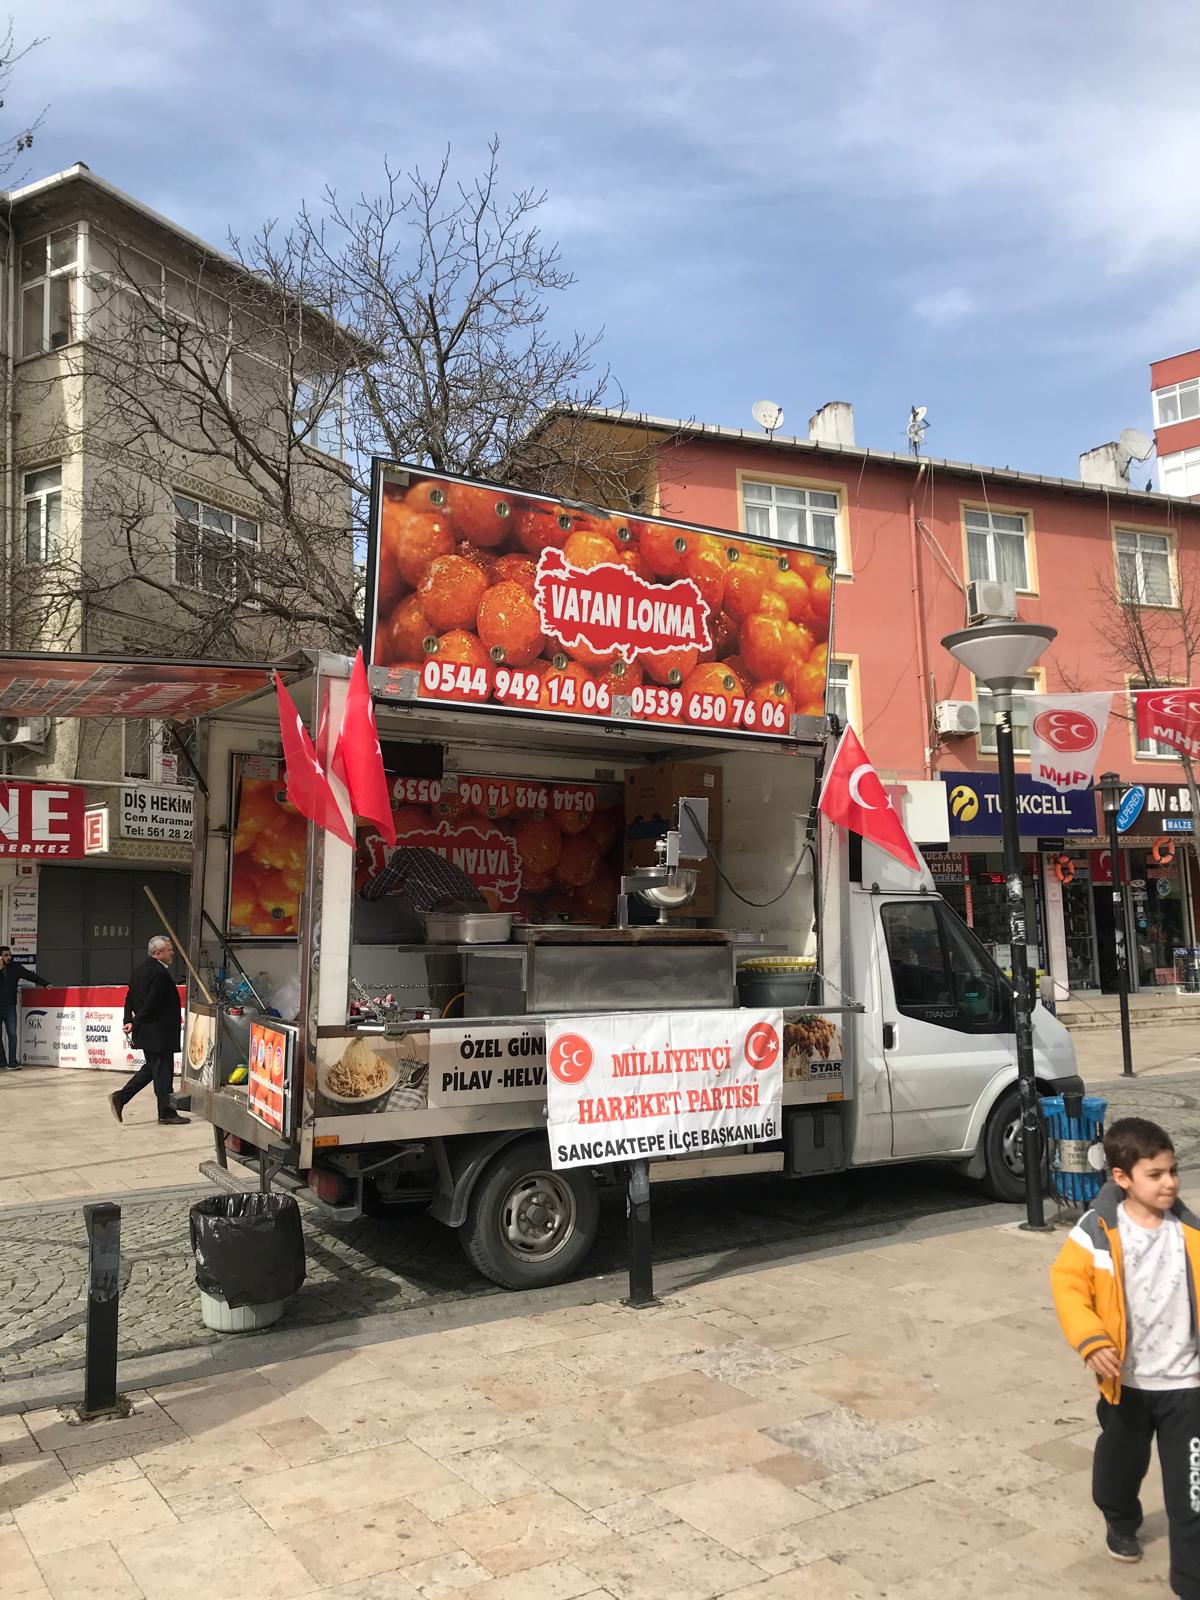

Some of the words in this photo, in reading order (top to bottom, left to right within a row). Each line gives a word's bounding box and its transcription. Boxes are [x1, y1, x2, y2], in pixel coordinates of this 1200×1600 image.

[551, 585, 621, 628] VATAN
[627, 597, 696, 639] LOKMA
[424, 661, 488, 695] 0544
[494, 670, 539, 701] 942
[548, 677, 575, 706] 14
[582, 682, 609, 710] 06
[631, 688, 683, 718] 0539
[689, 695, 726, 723] 650
[732, 700, 756, 726] 76
[761, 703, 785, 728] 06
[1153, 725, 1200, 754] MHP
[1040, 764, 1087, 786] MHP
[124, 790, 146, 813] DİŞ
[393, 779, 441, 802] 0539
[460, 783, 482, 805] 06
[488, 785, 509, 806] 14
[515, 787, 548, 809] 942
[553, 790, 595, 812] 0544
[1148, 787, 1167, 812] AV
[1169, 795, 1180, 812] &
[124, 813, 148, 823] Cem
[1118, 790, 1142, 827] ALPEREN
[125, 825, 144, 836] Tel:
[147, 828, 165, 838] 561
[168, 829, 181, 839] 28
[453, 847, 509, 875] VATAN
[86, 1024, 111, 1033] ANADOLU
[460, 1034, 503, 1059] ÖZEL
[508, 1032, 547, 1057] GÜN
[611, 1040, 732, 1078] MİLLİYETÇİ
[442, 1066, 493, 1092] PİLAV
[578, 1090, 681, 1124] HAREKET
[687, 1079, 760, 1113] PARTİSİ
[557, 1134, 666, 1163] SANCAKTEPE
[669, 1125, 699, 1153] İLÇE
[701, 1119, 777, 1148] BAŞKANLIĞI
